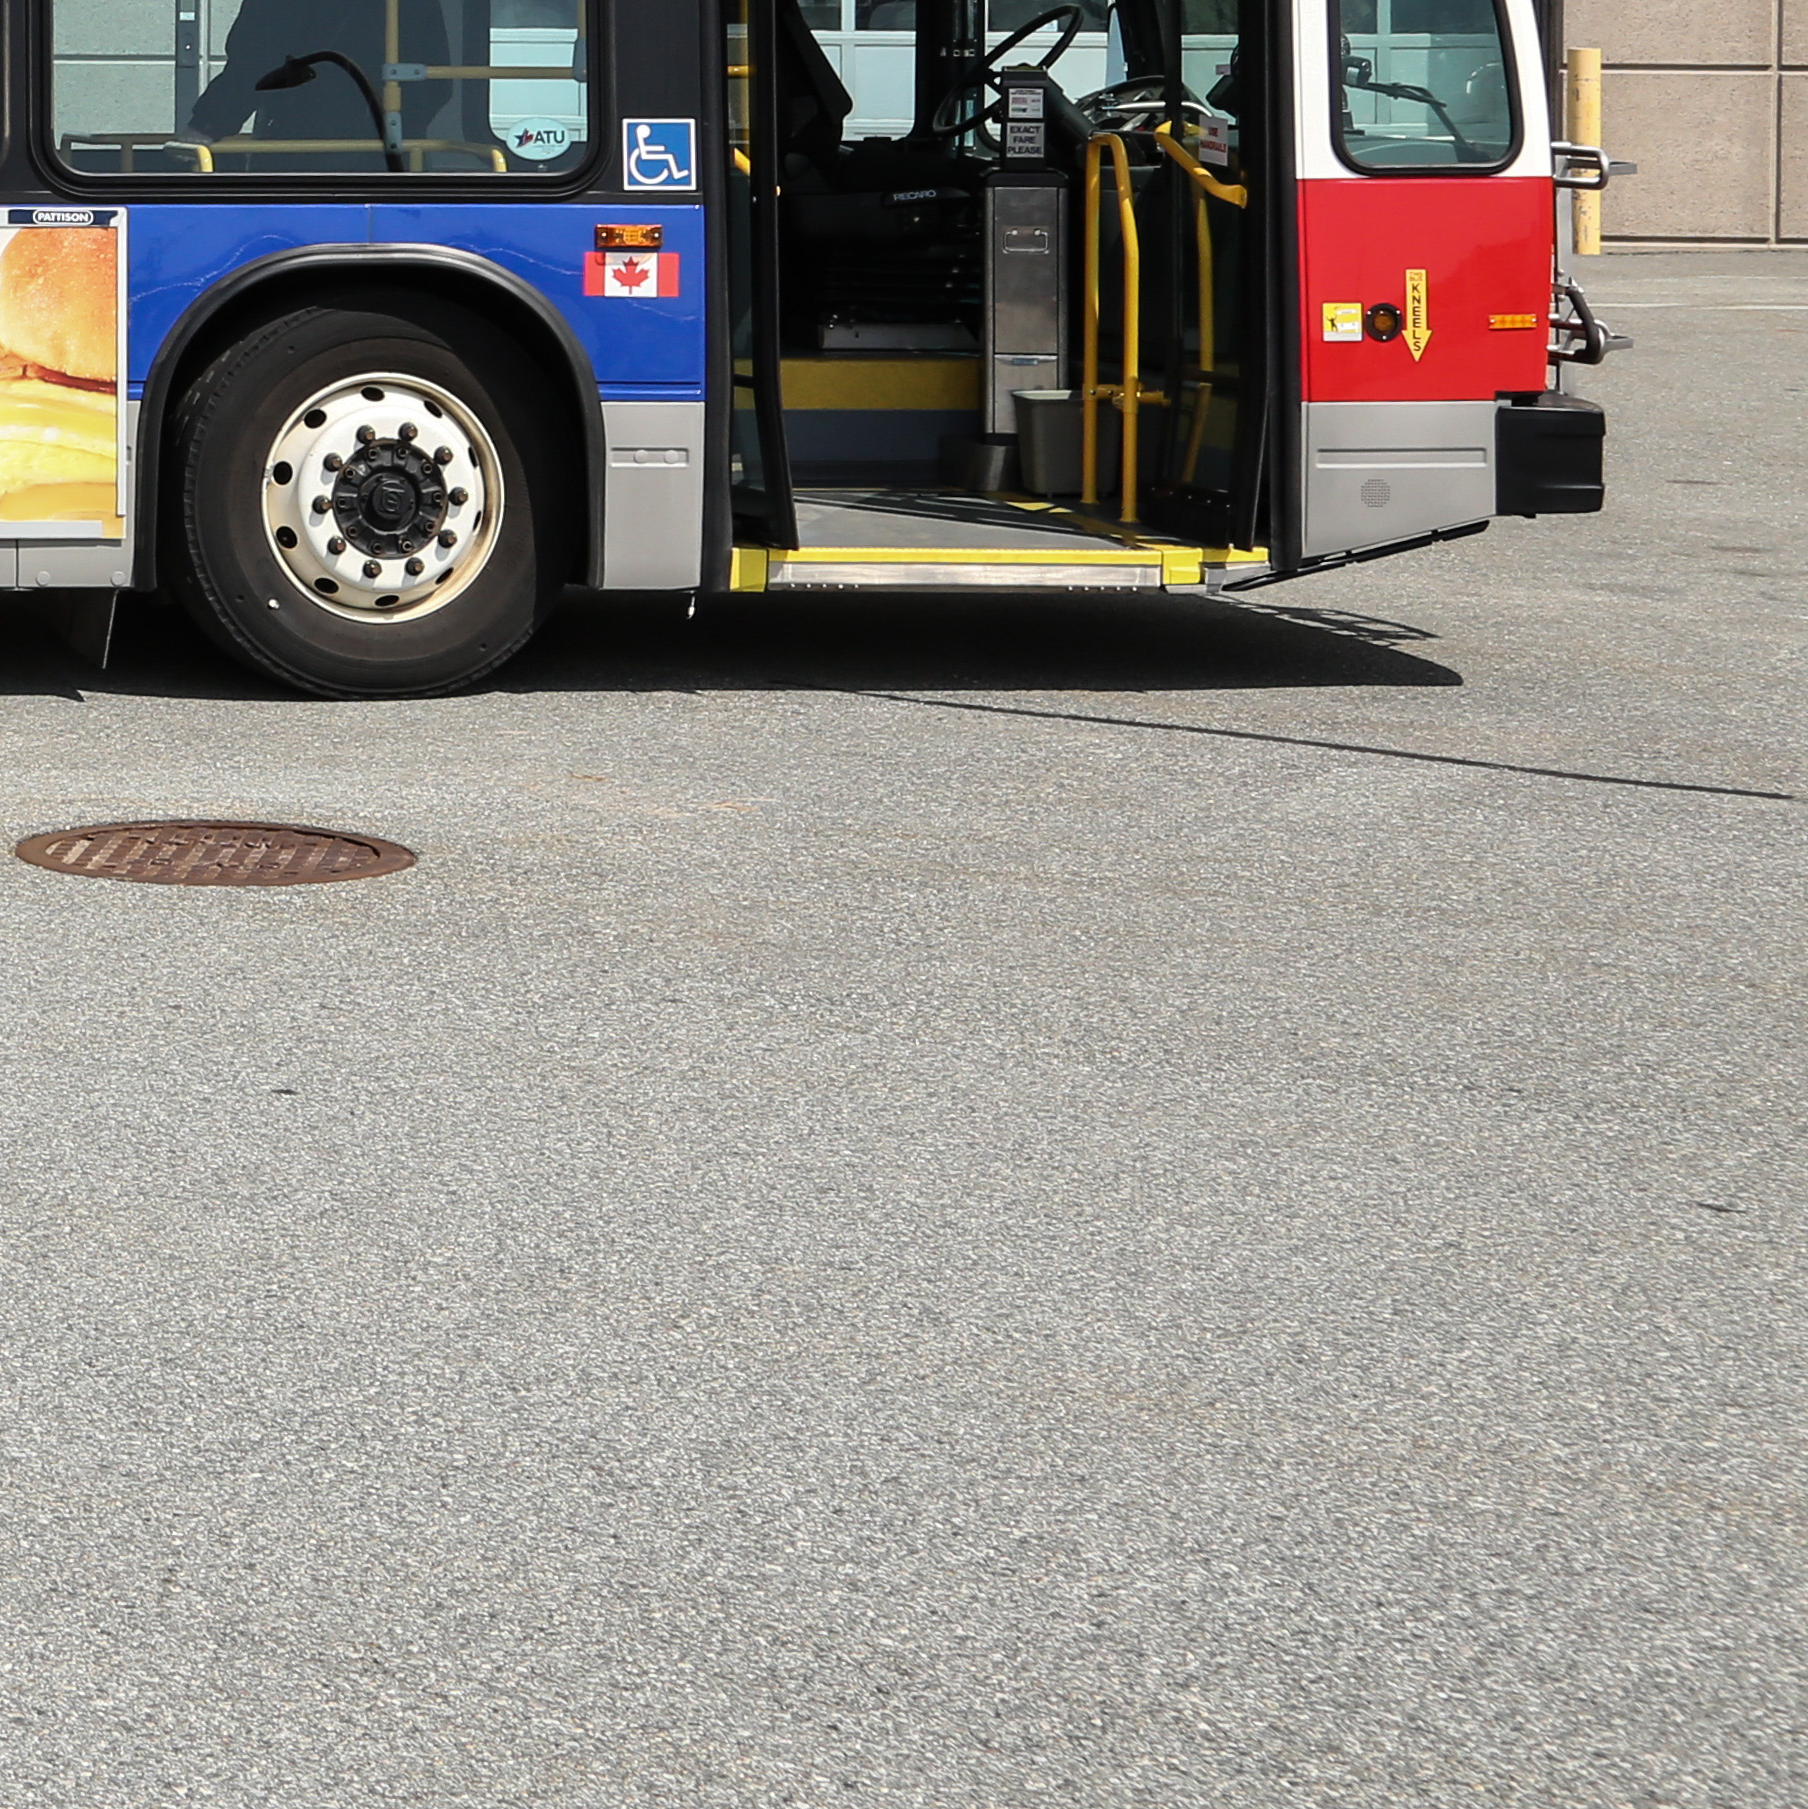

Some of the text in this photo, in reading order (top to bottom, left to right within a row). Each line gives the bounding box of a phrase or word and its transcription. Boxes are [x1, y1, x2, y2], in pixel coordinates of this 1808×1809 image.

[1009, 125, 1041, 134] EXACT
[533, 130, 565, 144] ATU
[1013, 135, 1036, 144] FARE
[1007, 146, 1043, 155] PLEASE
[893, 189, 937, 201] RECARO
[37, 212, 89, 223] PATTISON
[1411, 283, 1422, 352] KNEELS
